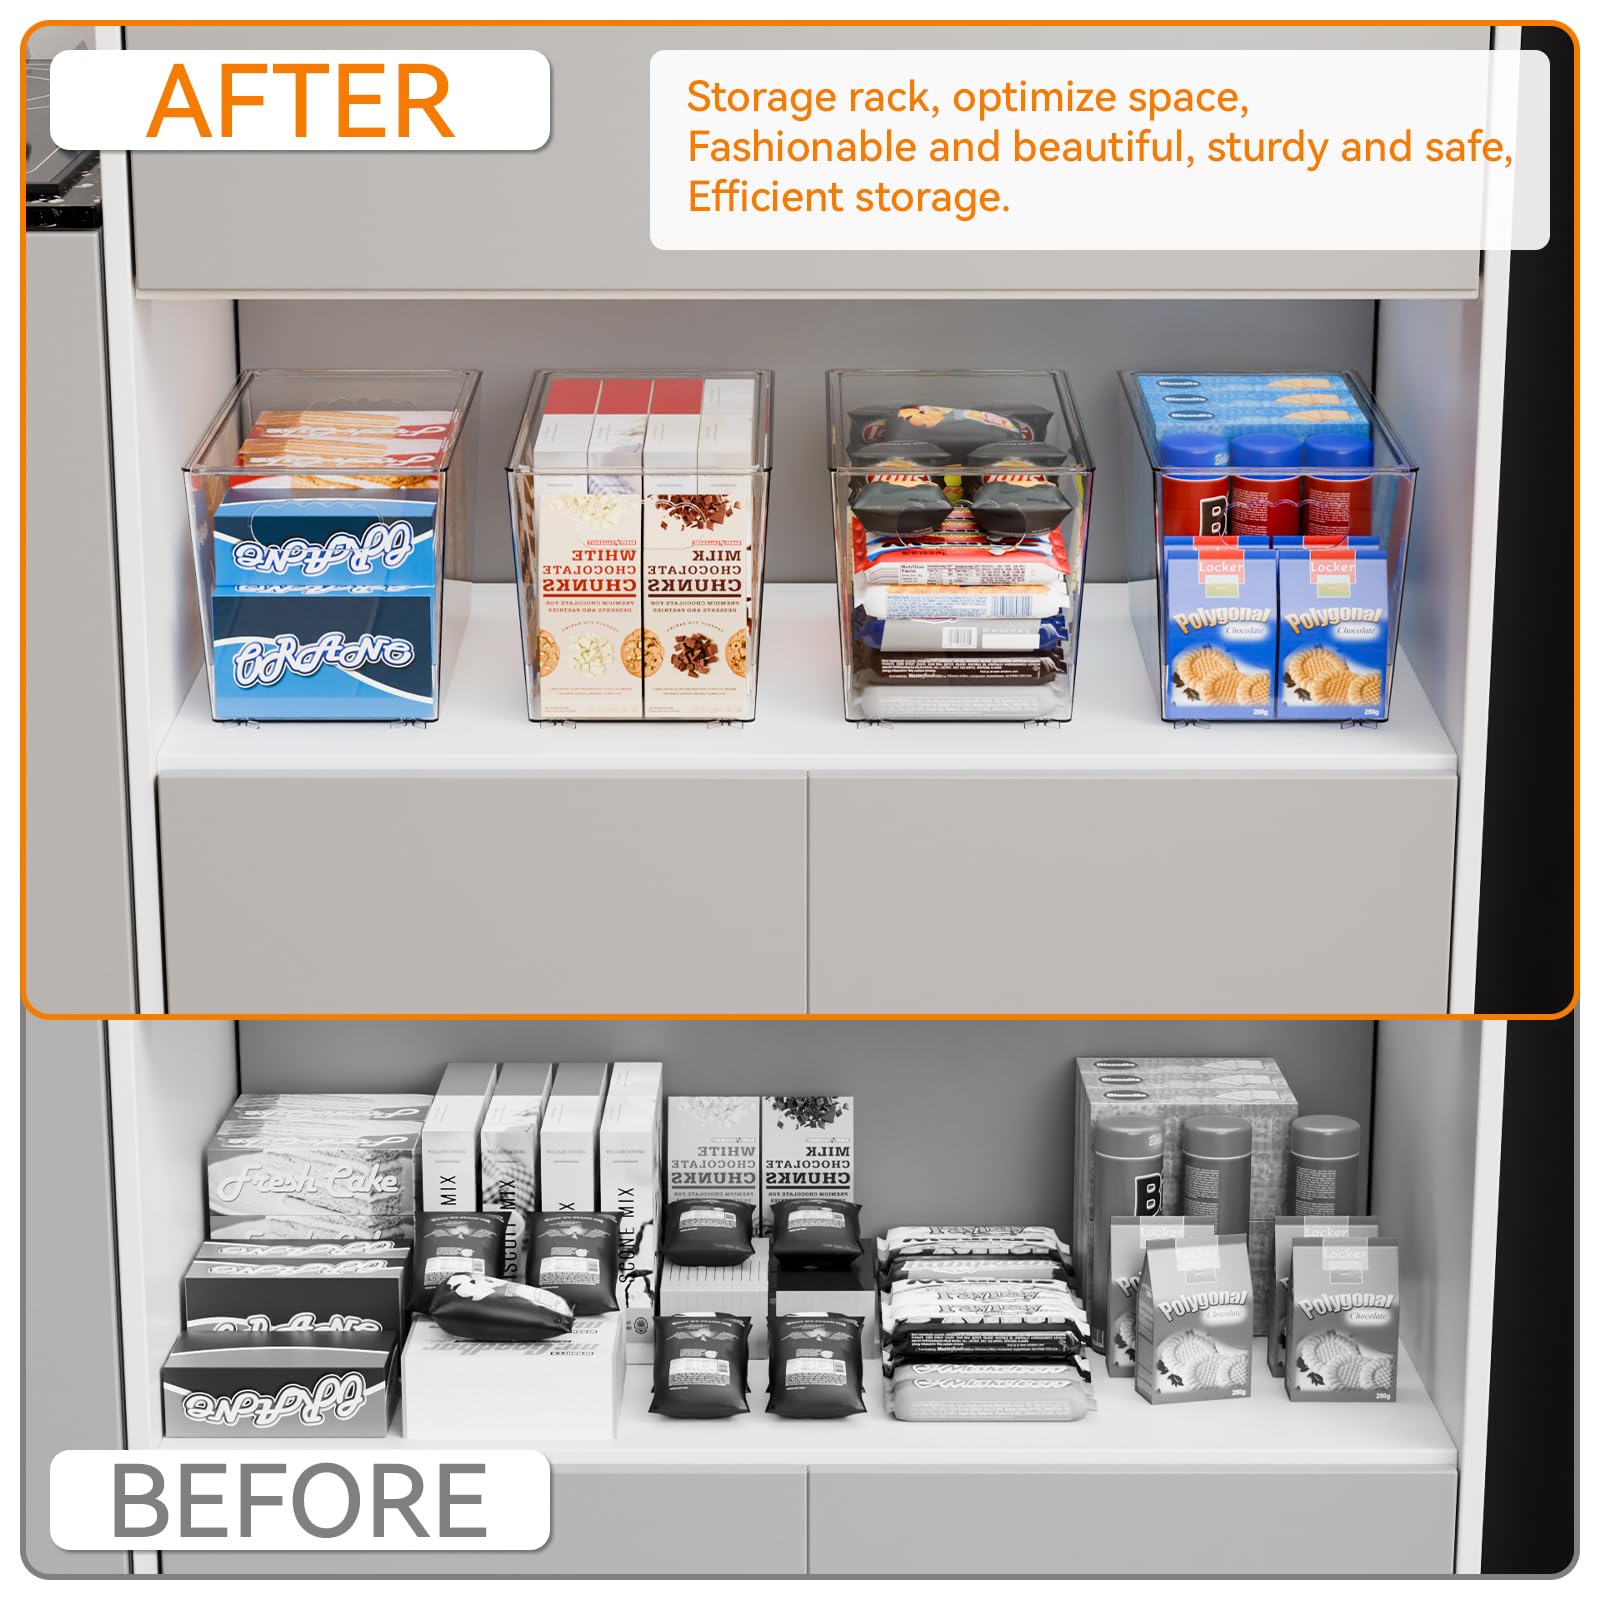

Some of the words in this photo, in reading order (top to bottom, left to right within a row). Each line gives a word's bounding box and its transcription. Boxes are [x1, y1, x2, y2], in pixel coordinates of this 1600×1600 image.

[1200, 561, 1244, 572] Locker
[1311, 561, 1355, 572] Locker
[1173, 607, 1272, 634] Polygonal
[1226, 626, 1265, 635] Chocolate
[1284, 607, 1383, 634] Polygonal
[1337, 626, 1376, 635] Chocolate
[217, 1163, 318, 1202] Fresh
[324, 1163, 399, 1199] Cake
[440, 1175, 456, 1206] MIX
[500, 1179, 516, 1211] MIX
[618, 1187, 635, 1218] MIX
[1157, 1290, 1249, 1322] Polygonal
[1206, 1309, 1242, 1319] Chocolate
[1298, 1292, 1396, 1320] Polygonal
[1350, 1311, 1388, 1320] Chocolate
